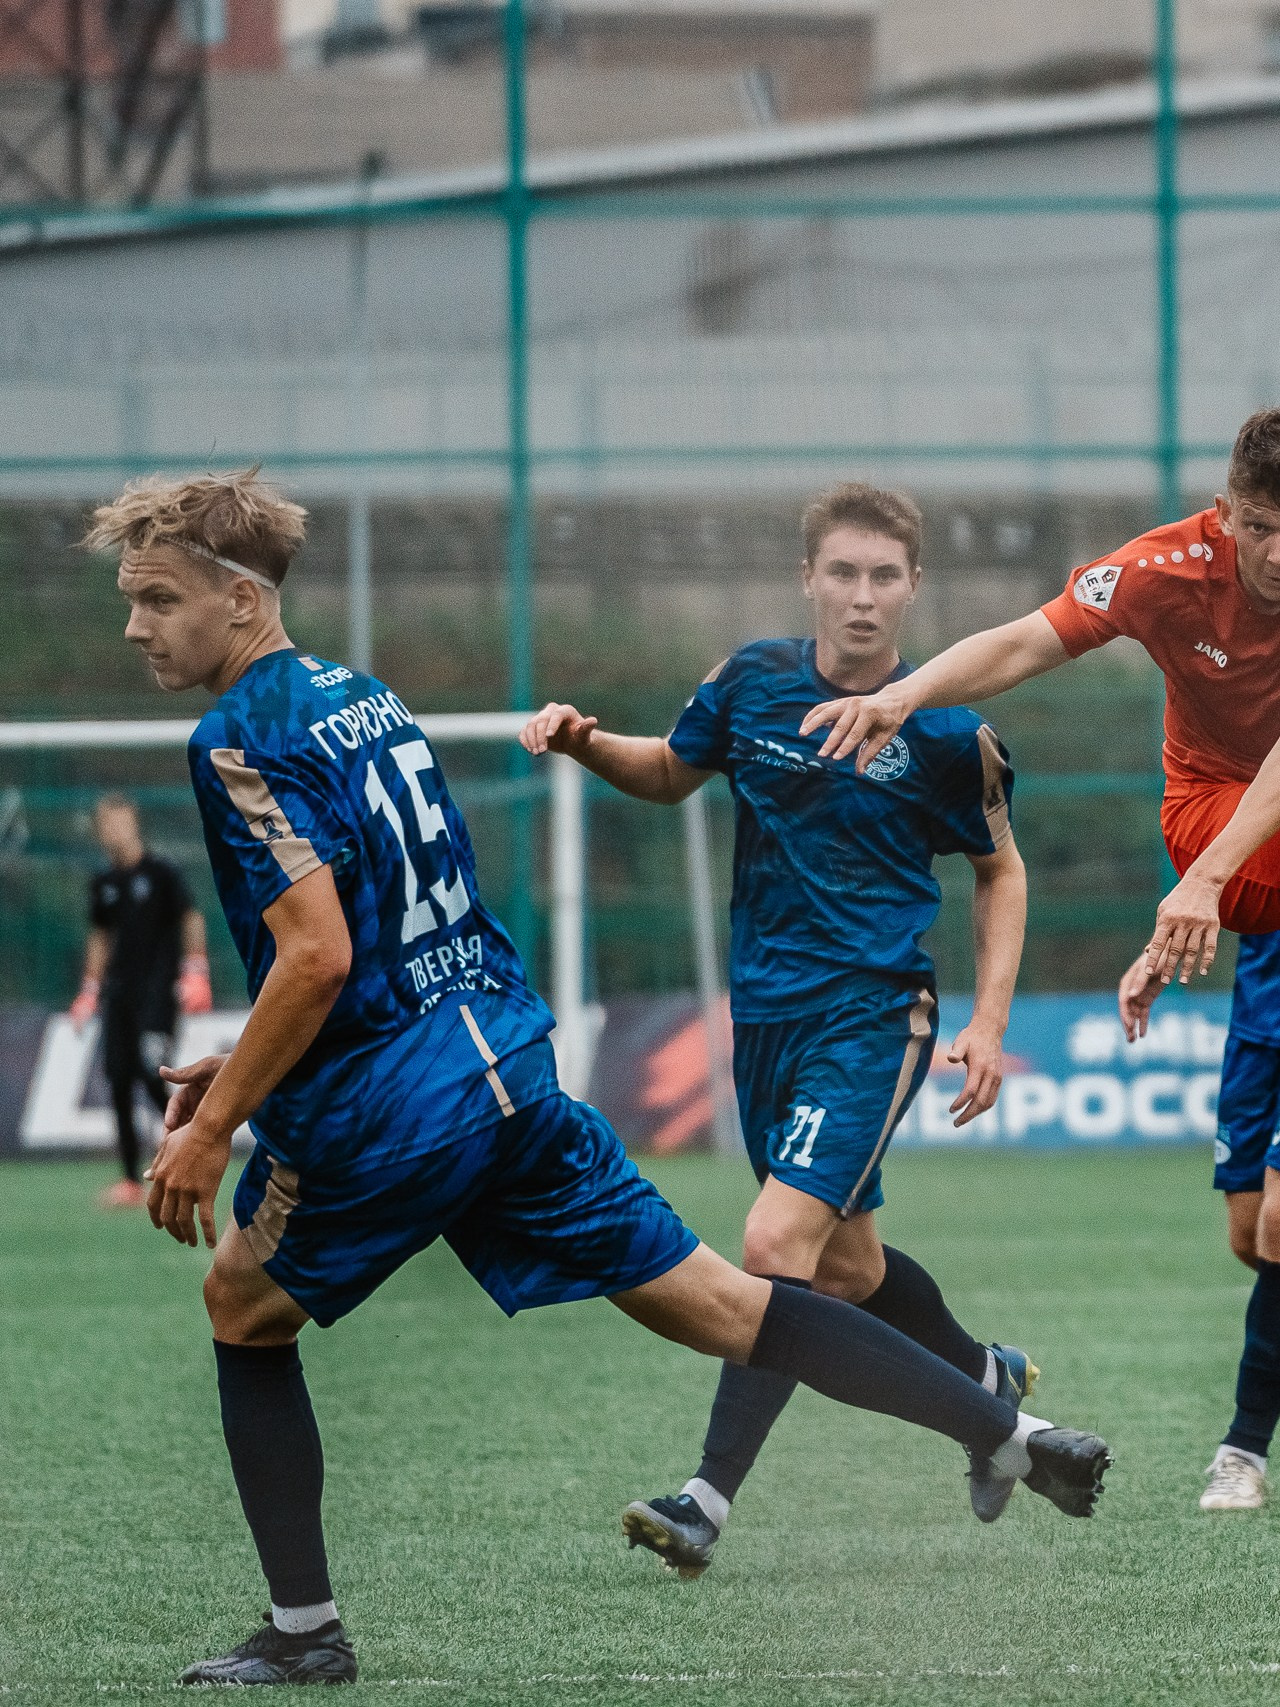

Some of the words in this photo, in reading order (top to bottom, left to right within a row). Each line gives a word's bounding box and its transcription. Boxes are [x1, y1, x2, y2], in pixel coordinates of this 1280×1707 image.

[1085, 572, 1107, 603] LEN
[1194, 641, 1228, 669] JAKO
[364, 739, 470, 945] 15
[778, 1105, 827, 1169] 71
